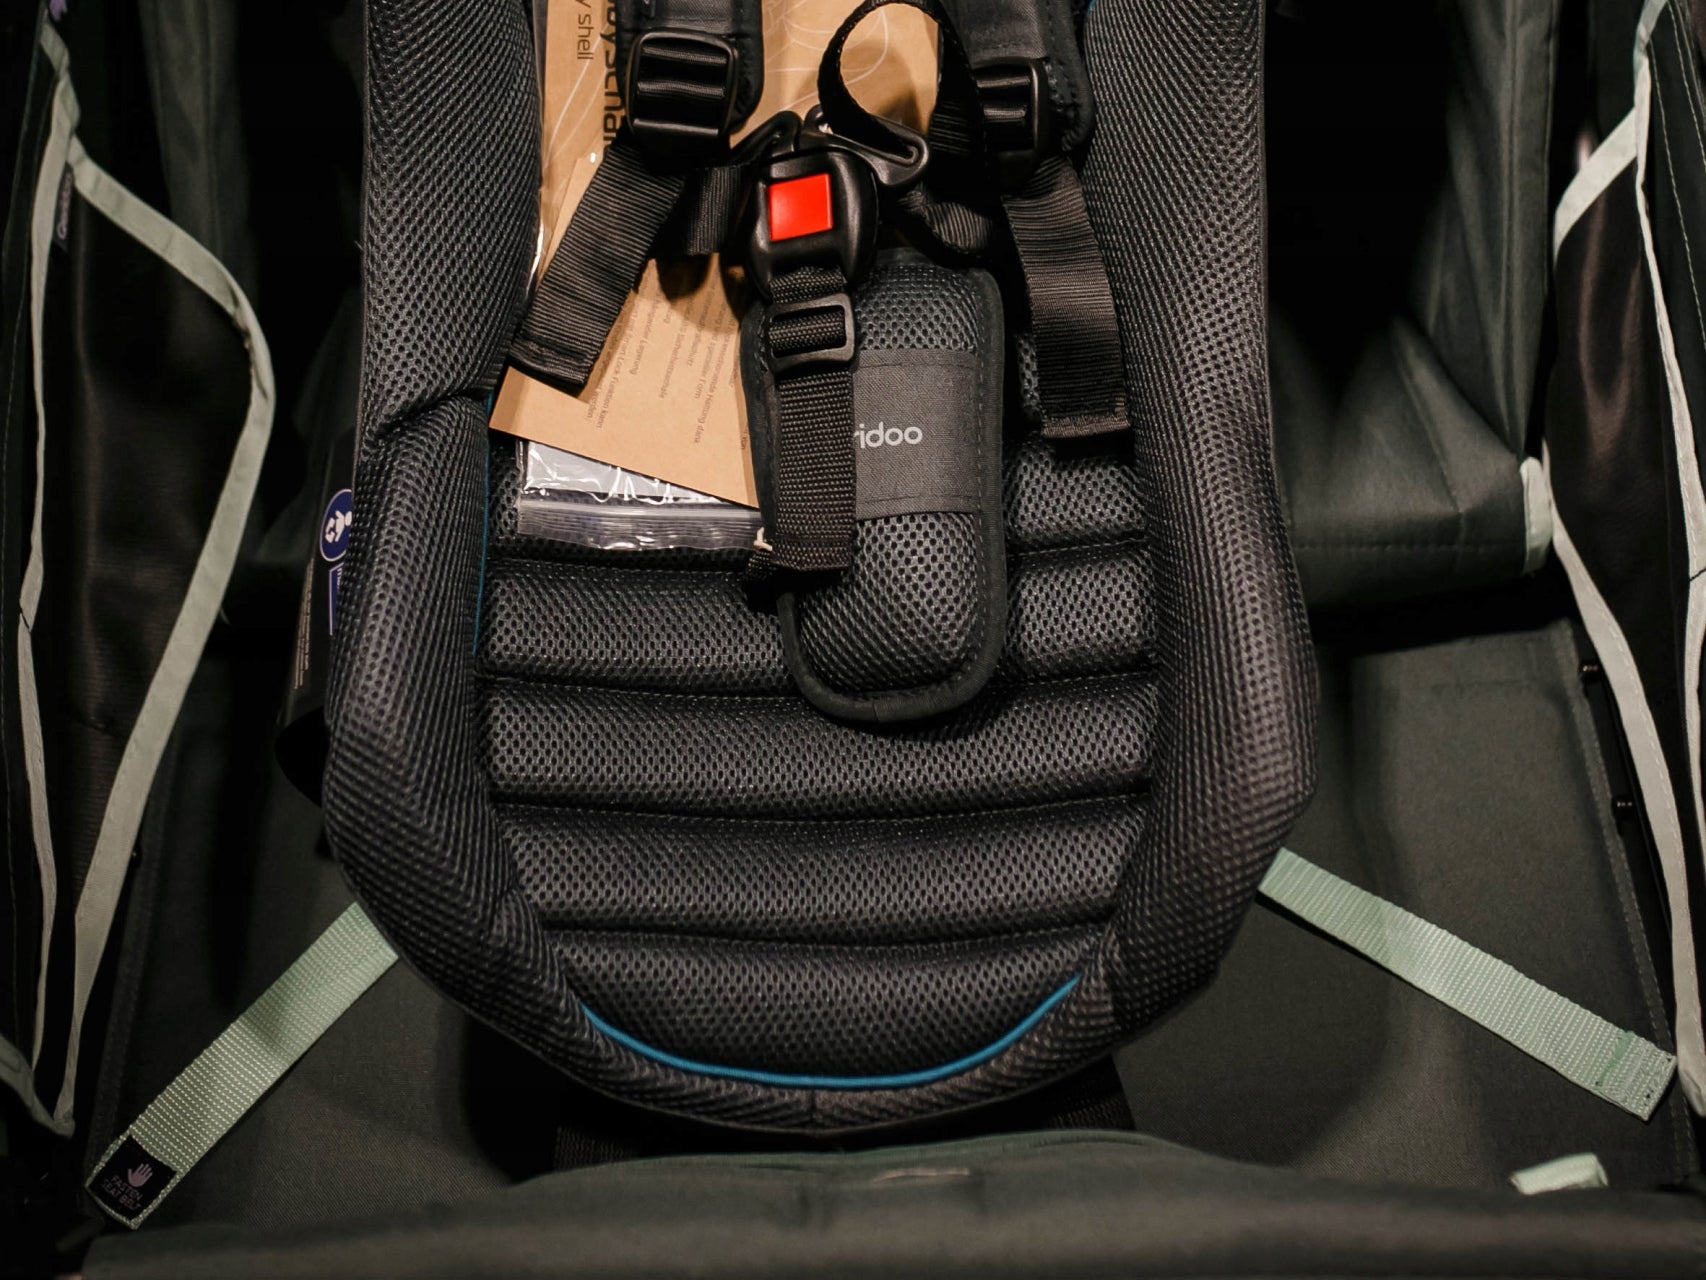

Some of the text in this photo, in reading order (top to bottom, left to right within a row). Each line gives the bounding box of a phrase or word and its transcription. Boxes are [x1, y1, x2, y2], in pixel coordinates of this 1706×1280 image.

[576, 13, 595, 60] shell
[611, 355, 625, 376] Lock
[600, 375, 619, 410] Funktion
[594, 408, 608, 429] kann
[102, 1179, 142, 1210] SEAT BELT
[112, 1174, 143, 1201] FASTEN
